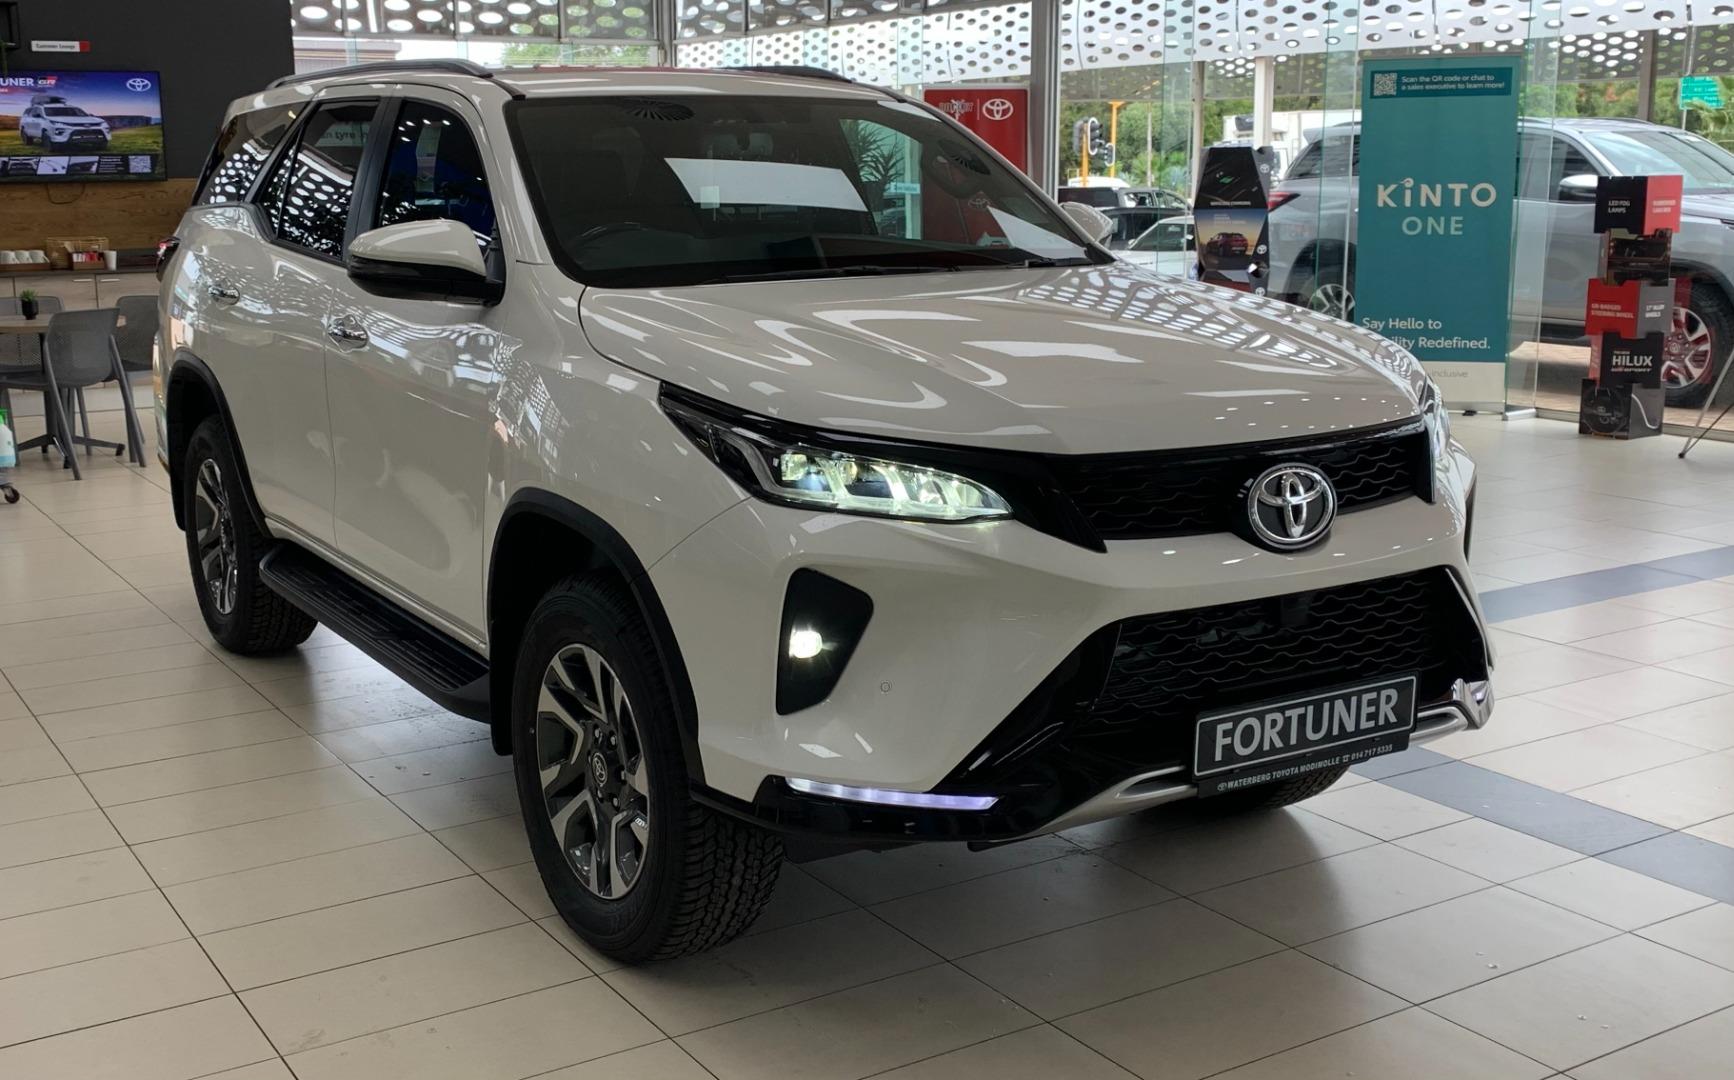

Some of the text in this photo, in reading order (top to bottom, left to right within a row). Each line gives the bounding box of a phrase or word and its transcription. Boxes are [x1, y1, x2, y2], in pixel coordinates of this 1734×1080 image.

[0, 78, 34, 87] UNER
[1402, 216, 1464, 236] ONE
[1362, 318, 1442, 331] Say Hello to
[1392, 336, 1490, 350] ility Redefined.
[1612, 355, 1653, 366] HILUX
[1214, 688, 1399, 762] FORTUNER
[1228, 773, 1271, 790] WATERBERG
[1272, 767, 1299, 780] TOYOTA
[1300, 758, 1340, 772] MODIMOLLE
[1351, 752, 1364, 761] 014
[1364, 749, 1377, 758] 717
